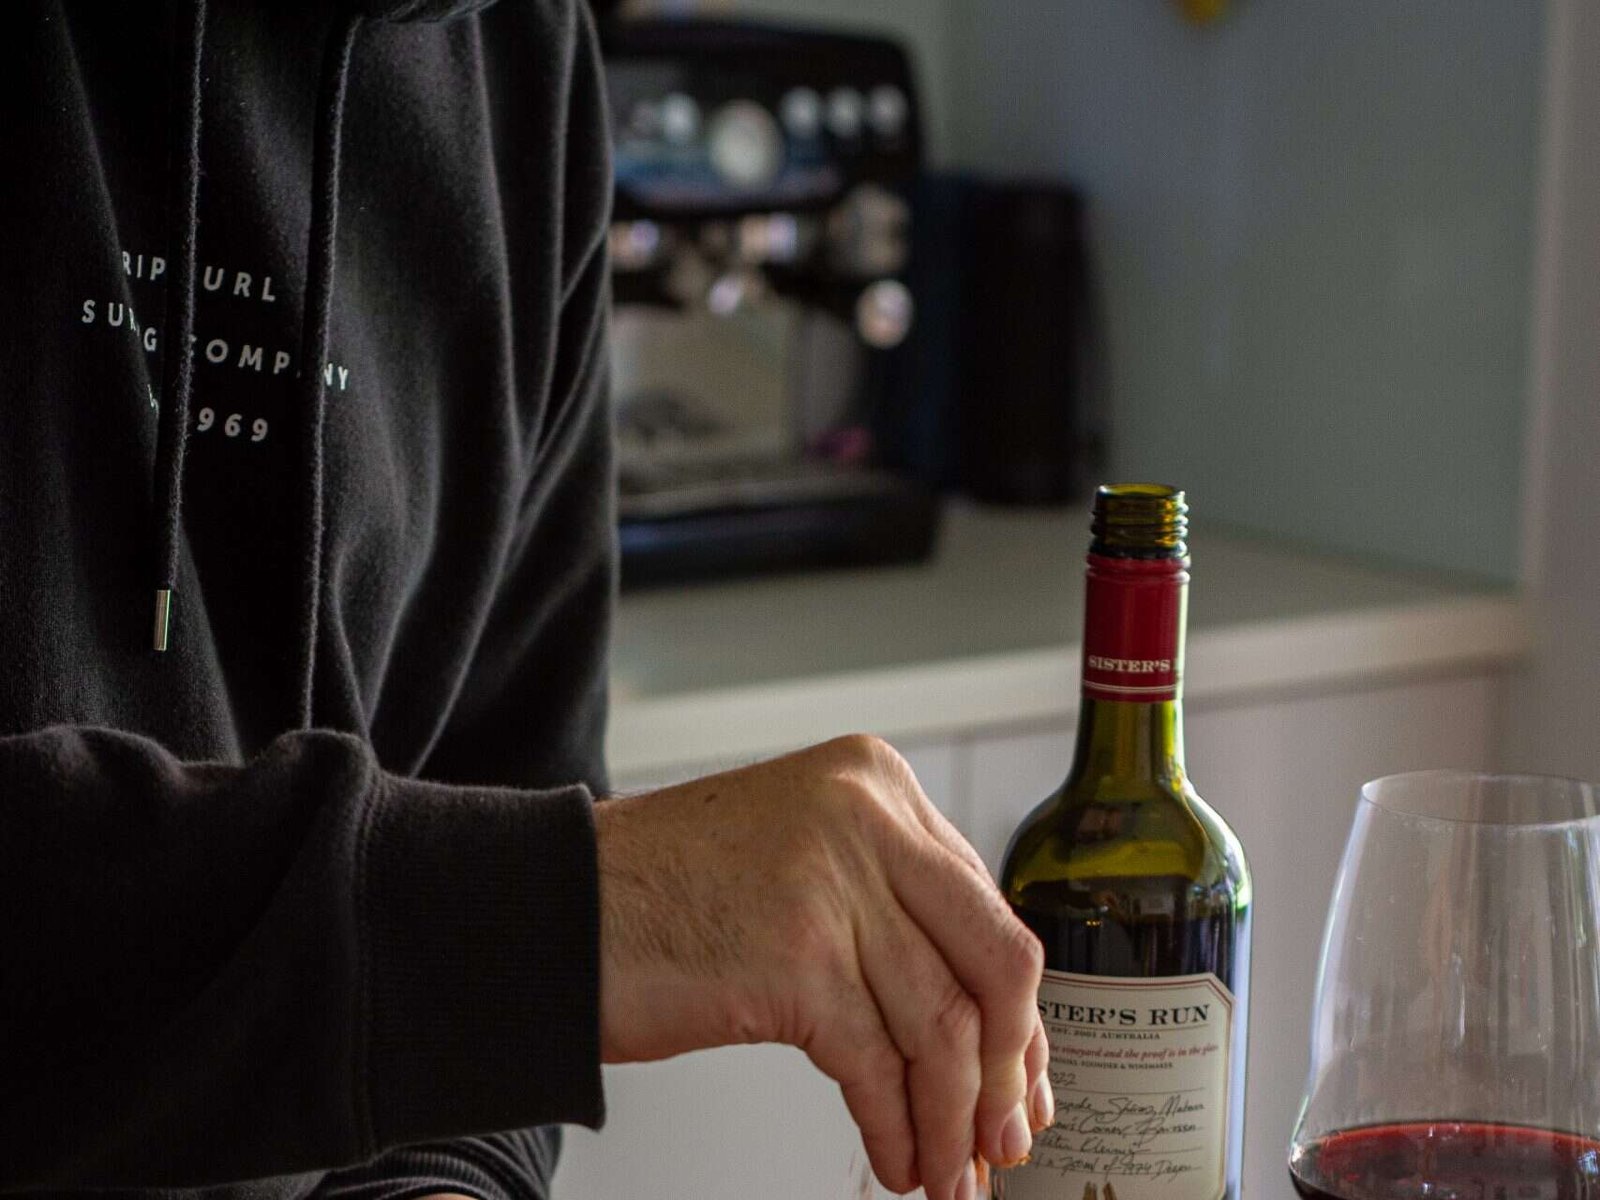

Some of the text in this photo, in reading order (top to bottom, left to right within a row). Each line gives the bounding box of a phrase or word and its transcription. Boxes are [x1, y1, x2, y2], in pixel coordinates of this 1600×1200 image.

[203, 265, 276, 302] URL
[196, 407, 269, 441] 969
[1088, 655, 1171, 673] SISTER'S
[1037, 1000, 1211, 1026] STER'S RUN
[1100, 1031, 1161, 1040] AUSTRALIA
[1103, 1047, 1123, 1058] and
[1124, 1047, 1140, 1059] the
[1141, 1047, 1168, 1061] proof
[1177, 1046, 1187, 1056] in
